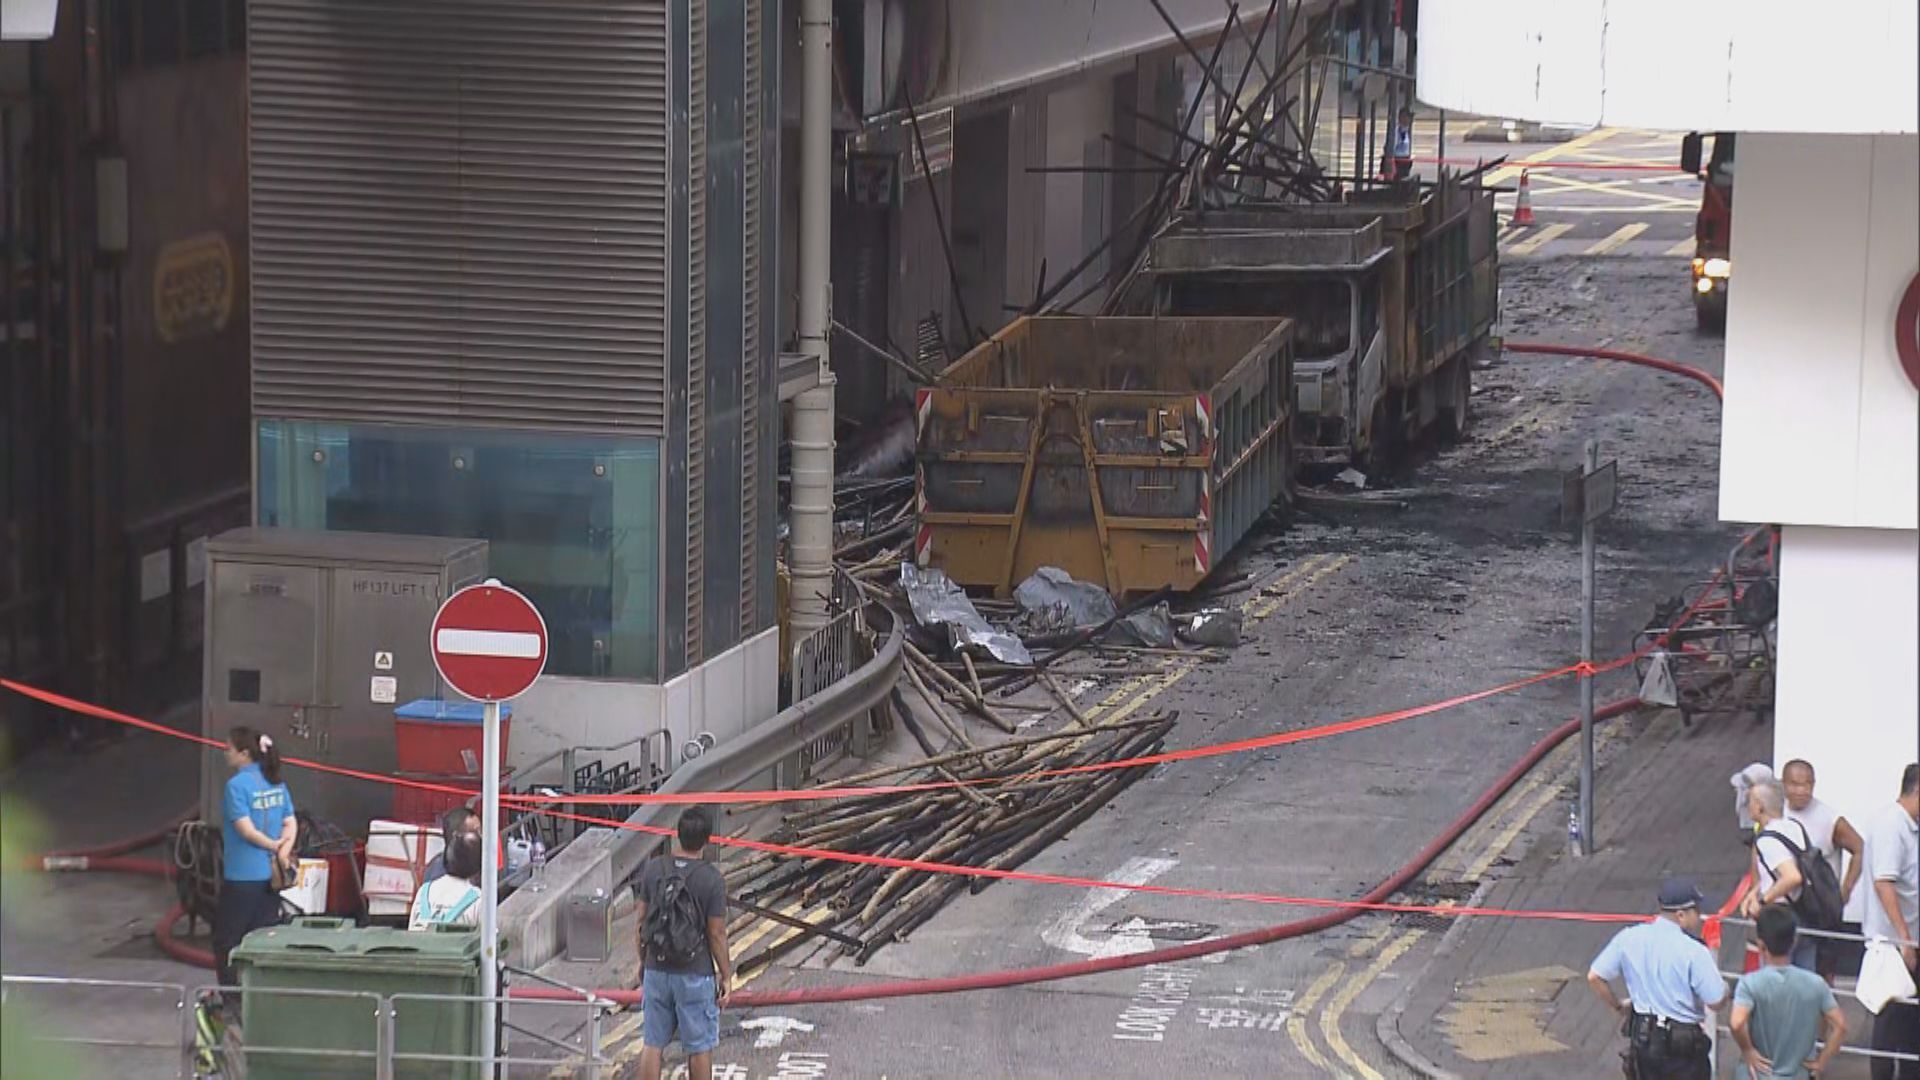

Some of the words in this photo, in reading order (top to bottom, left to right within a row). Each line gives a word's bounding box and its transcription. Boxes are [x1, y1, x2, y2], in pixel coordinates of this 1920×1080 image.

[353, 581, 389, 593] HF137
[392, 583, 416, 595] LIFT
[1113, 1005, 1177, 1041] LOOK
[768, 1052, 829, 1080] LOO
